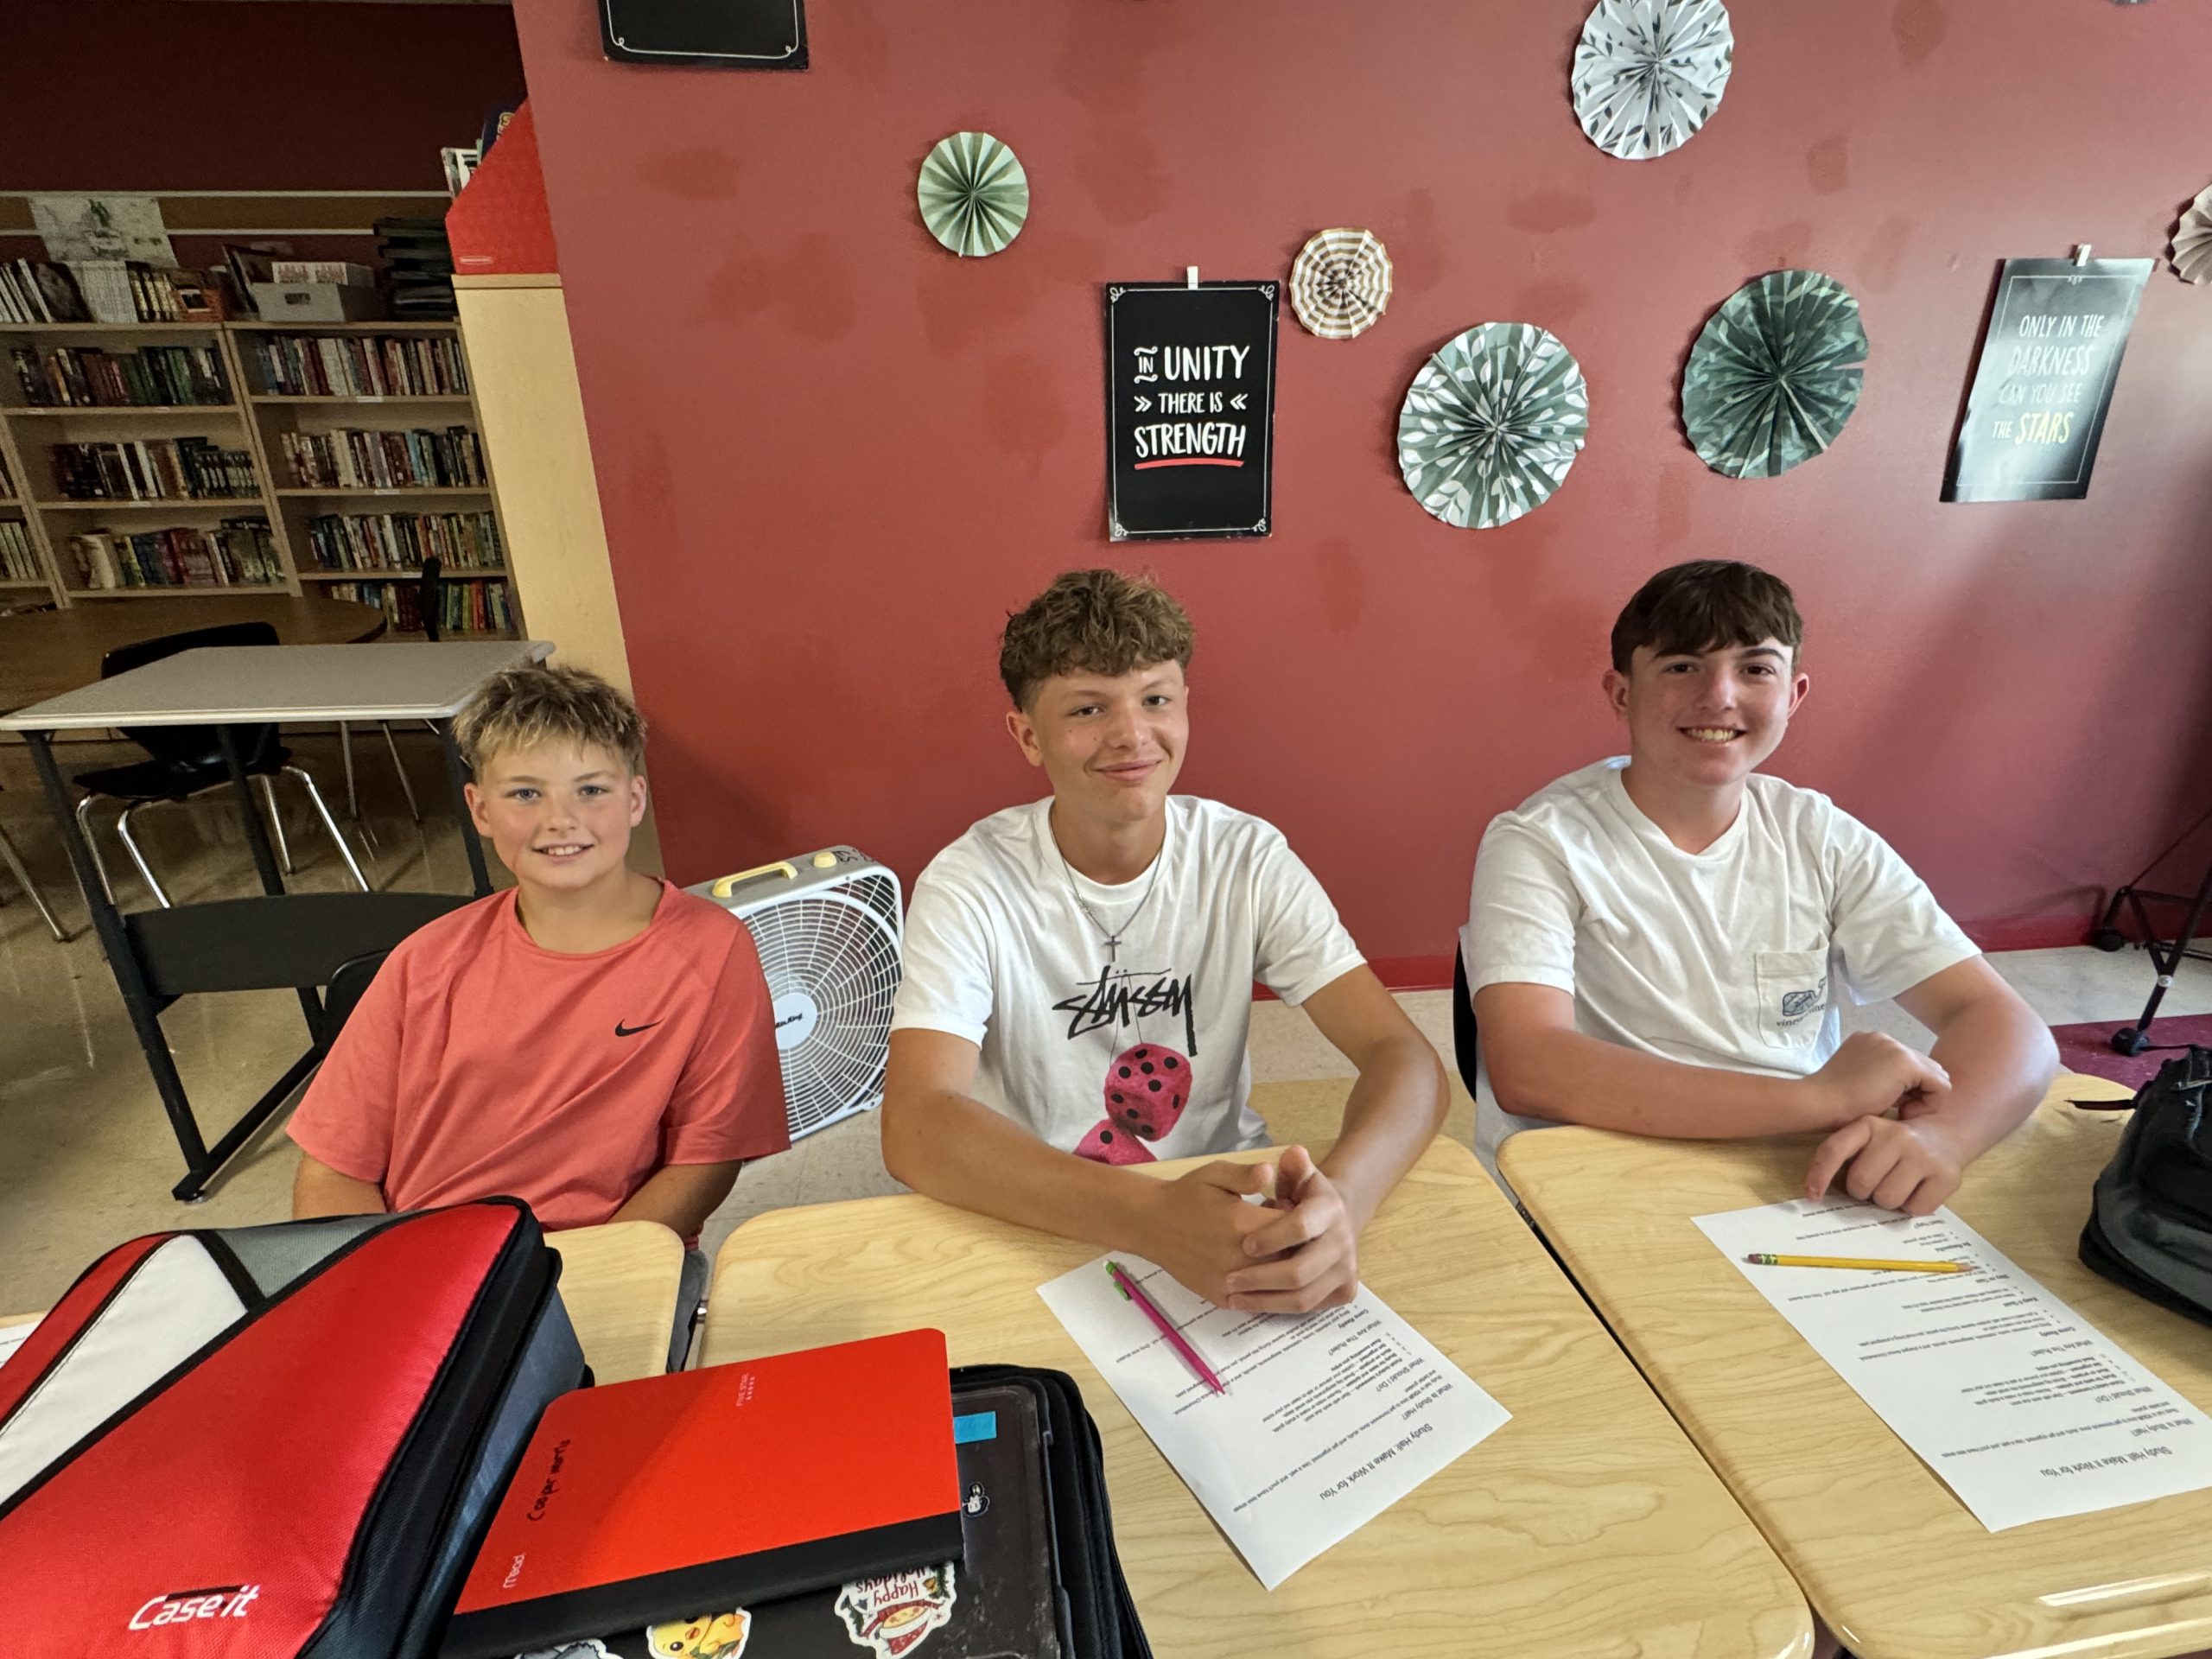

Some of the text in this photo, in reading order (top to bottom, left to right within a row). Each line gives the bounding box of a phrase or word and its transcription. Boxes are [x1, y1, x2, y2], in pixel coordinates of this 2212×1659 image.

[2019, 315, 2105, 338] ONLY IN THE
[1139, 346, 1250, 381] IN UNITY
[2008, 346, 2094, 375] DARKNESS
[1158, 392, 1224, 414] THERE IS
[2031, 384, 2055, 404] YOU
[2058, 383, 2082, 404] SEE
[1134, 422, 1246, 458] STRENGTH
[1993, 411, 2074, 445] THE STARS
[1319, 1421, 1433, 1502] Study Hall: Make It Work for You
[874, 1580, 919, 1607] Happy
